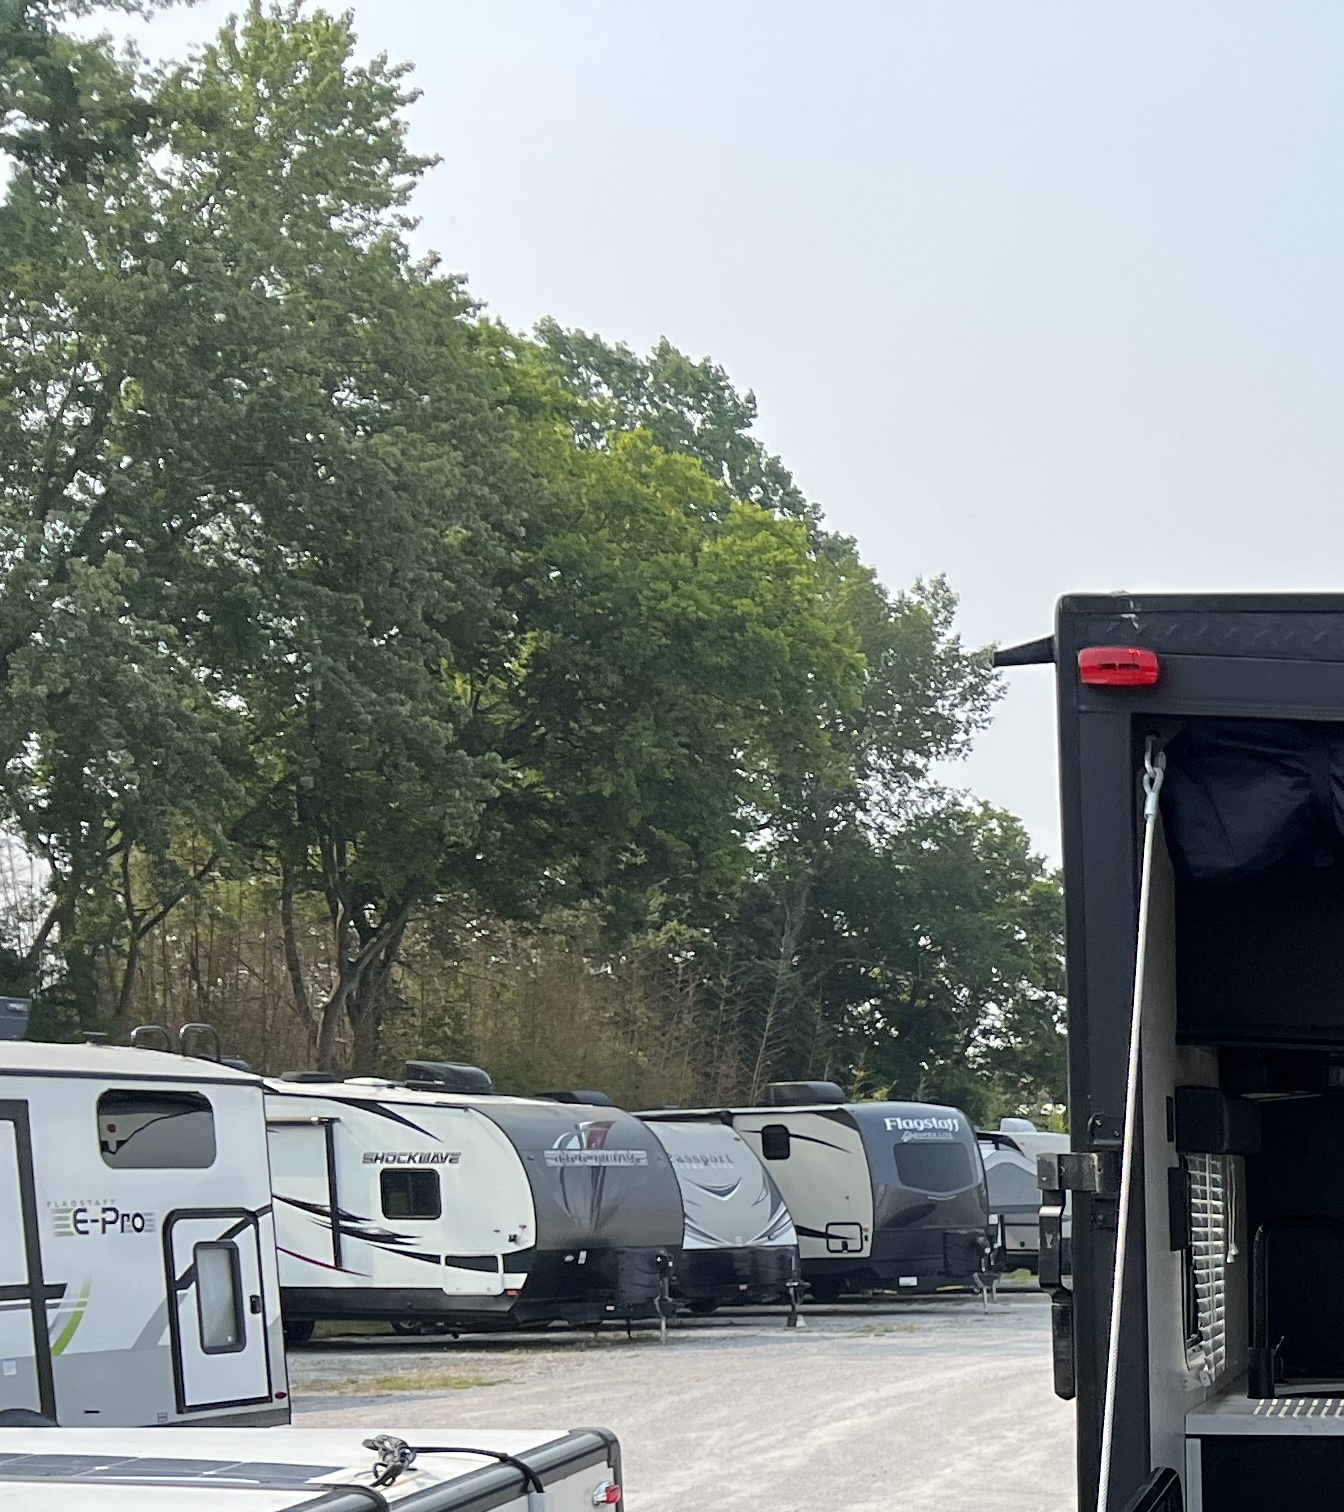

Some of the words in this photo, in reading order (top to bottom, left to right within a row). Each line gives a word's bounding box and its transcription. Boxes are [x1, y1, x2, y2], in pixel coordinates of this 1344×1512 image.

[883, 1116, 960, 1132] Flagstaff
[362, 1151, 462, 1164] SHOCKWAVE
[669, 1153, 734, 1167] assport
[46, 1199, 116, 1208] FLAGSTAFF
[72, 1206, 145, 1235] E-Pro
